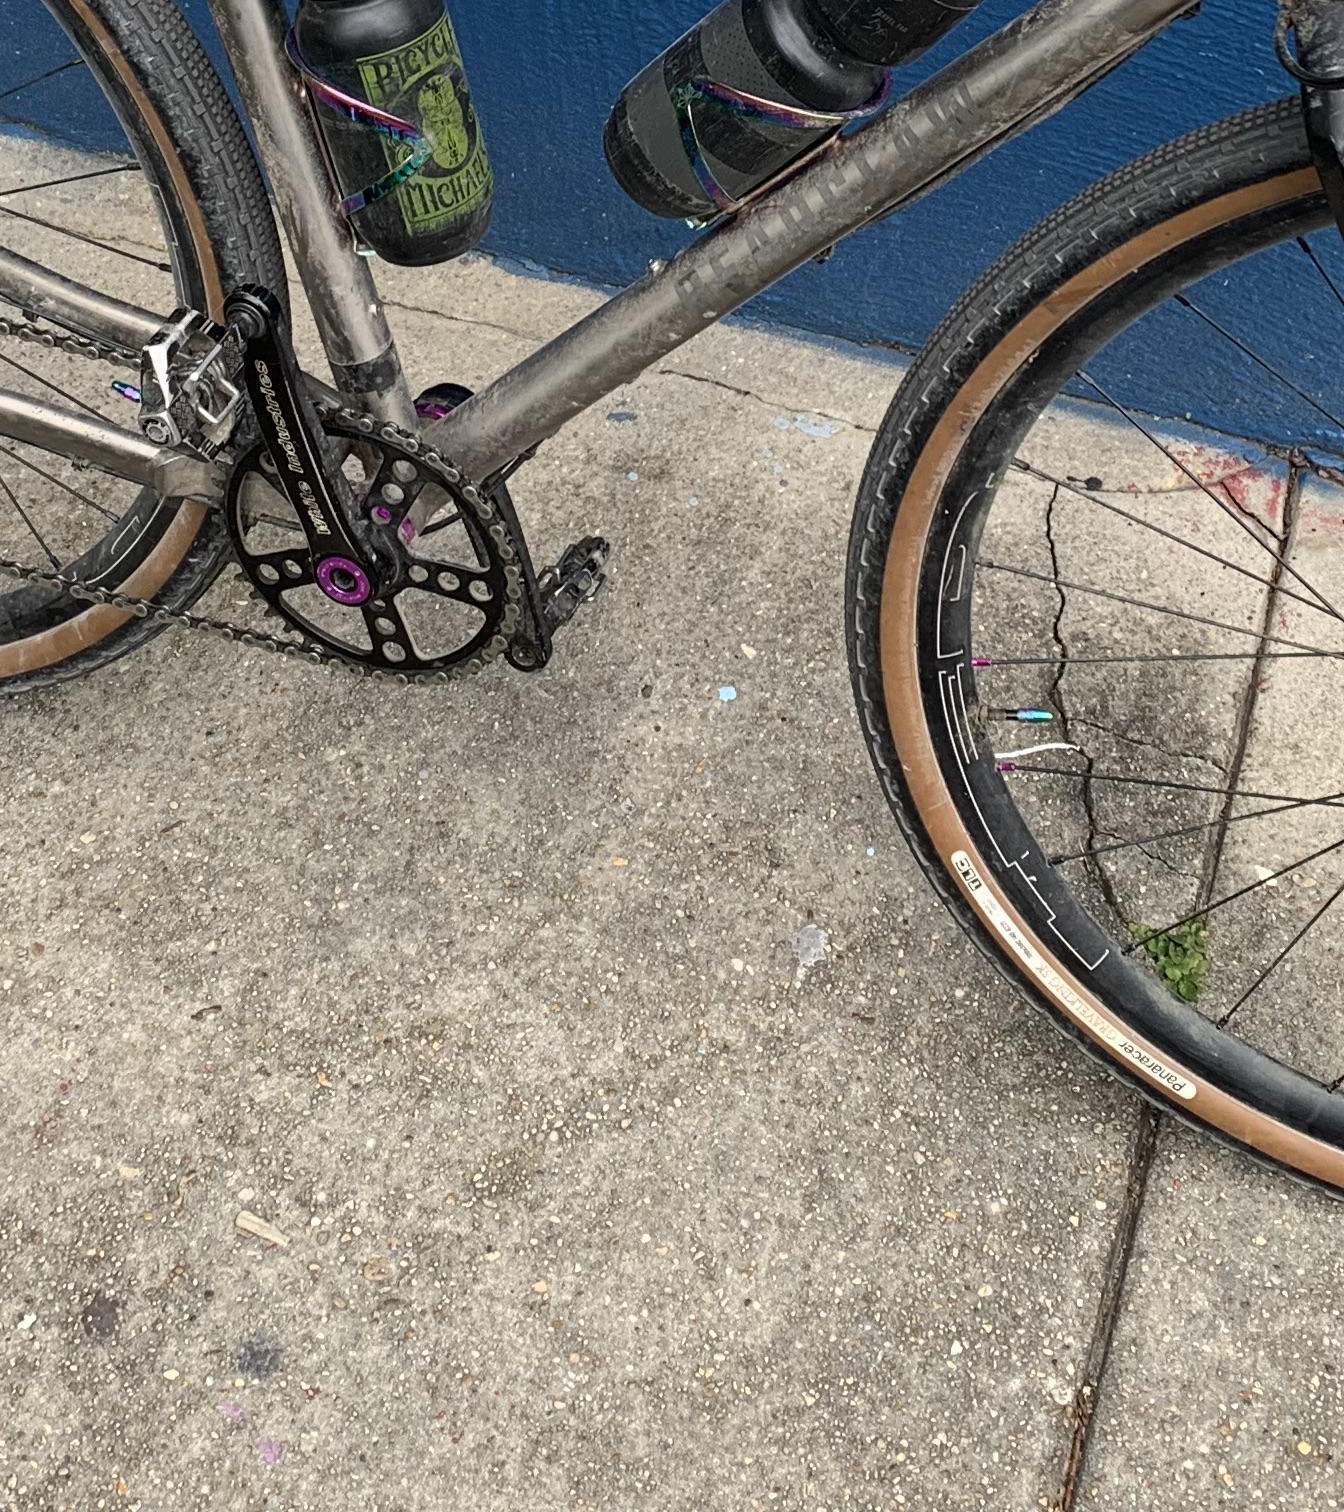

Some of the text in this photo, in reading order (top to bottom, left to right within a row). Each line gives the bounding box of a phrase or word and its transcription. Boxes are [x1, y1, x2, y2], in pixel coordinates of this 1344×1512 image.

[370, 20, 457, 95] BICYCL
[405, 152, 490, 220] MICHAEL
[255, 358, 332, 536] White Industries
[955, 857, 983, 892] TLC
[1046, 973, 1117, 1041] GRAVELKING
[1117, 1040, 1186, 1093] Panaracer
